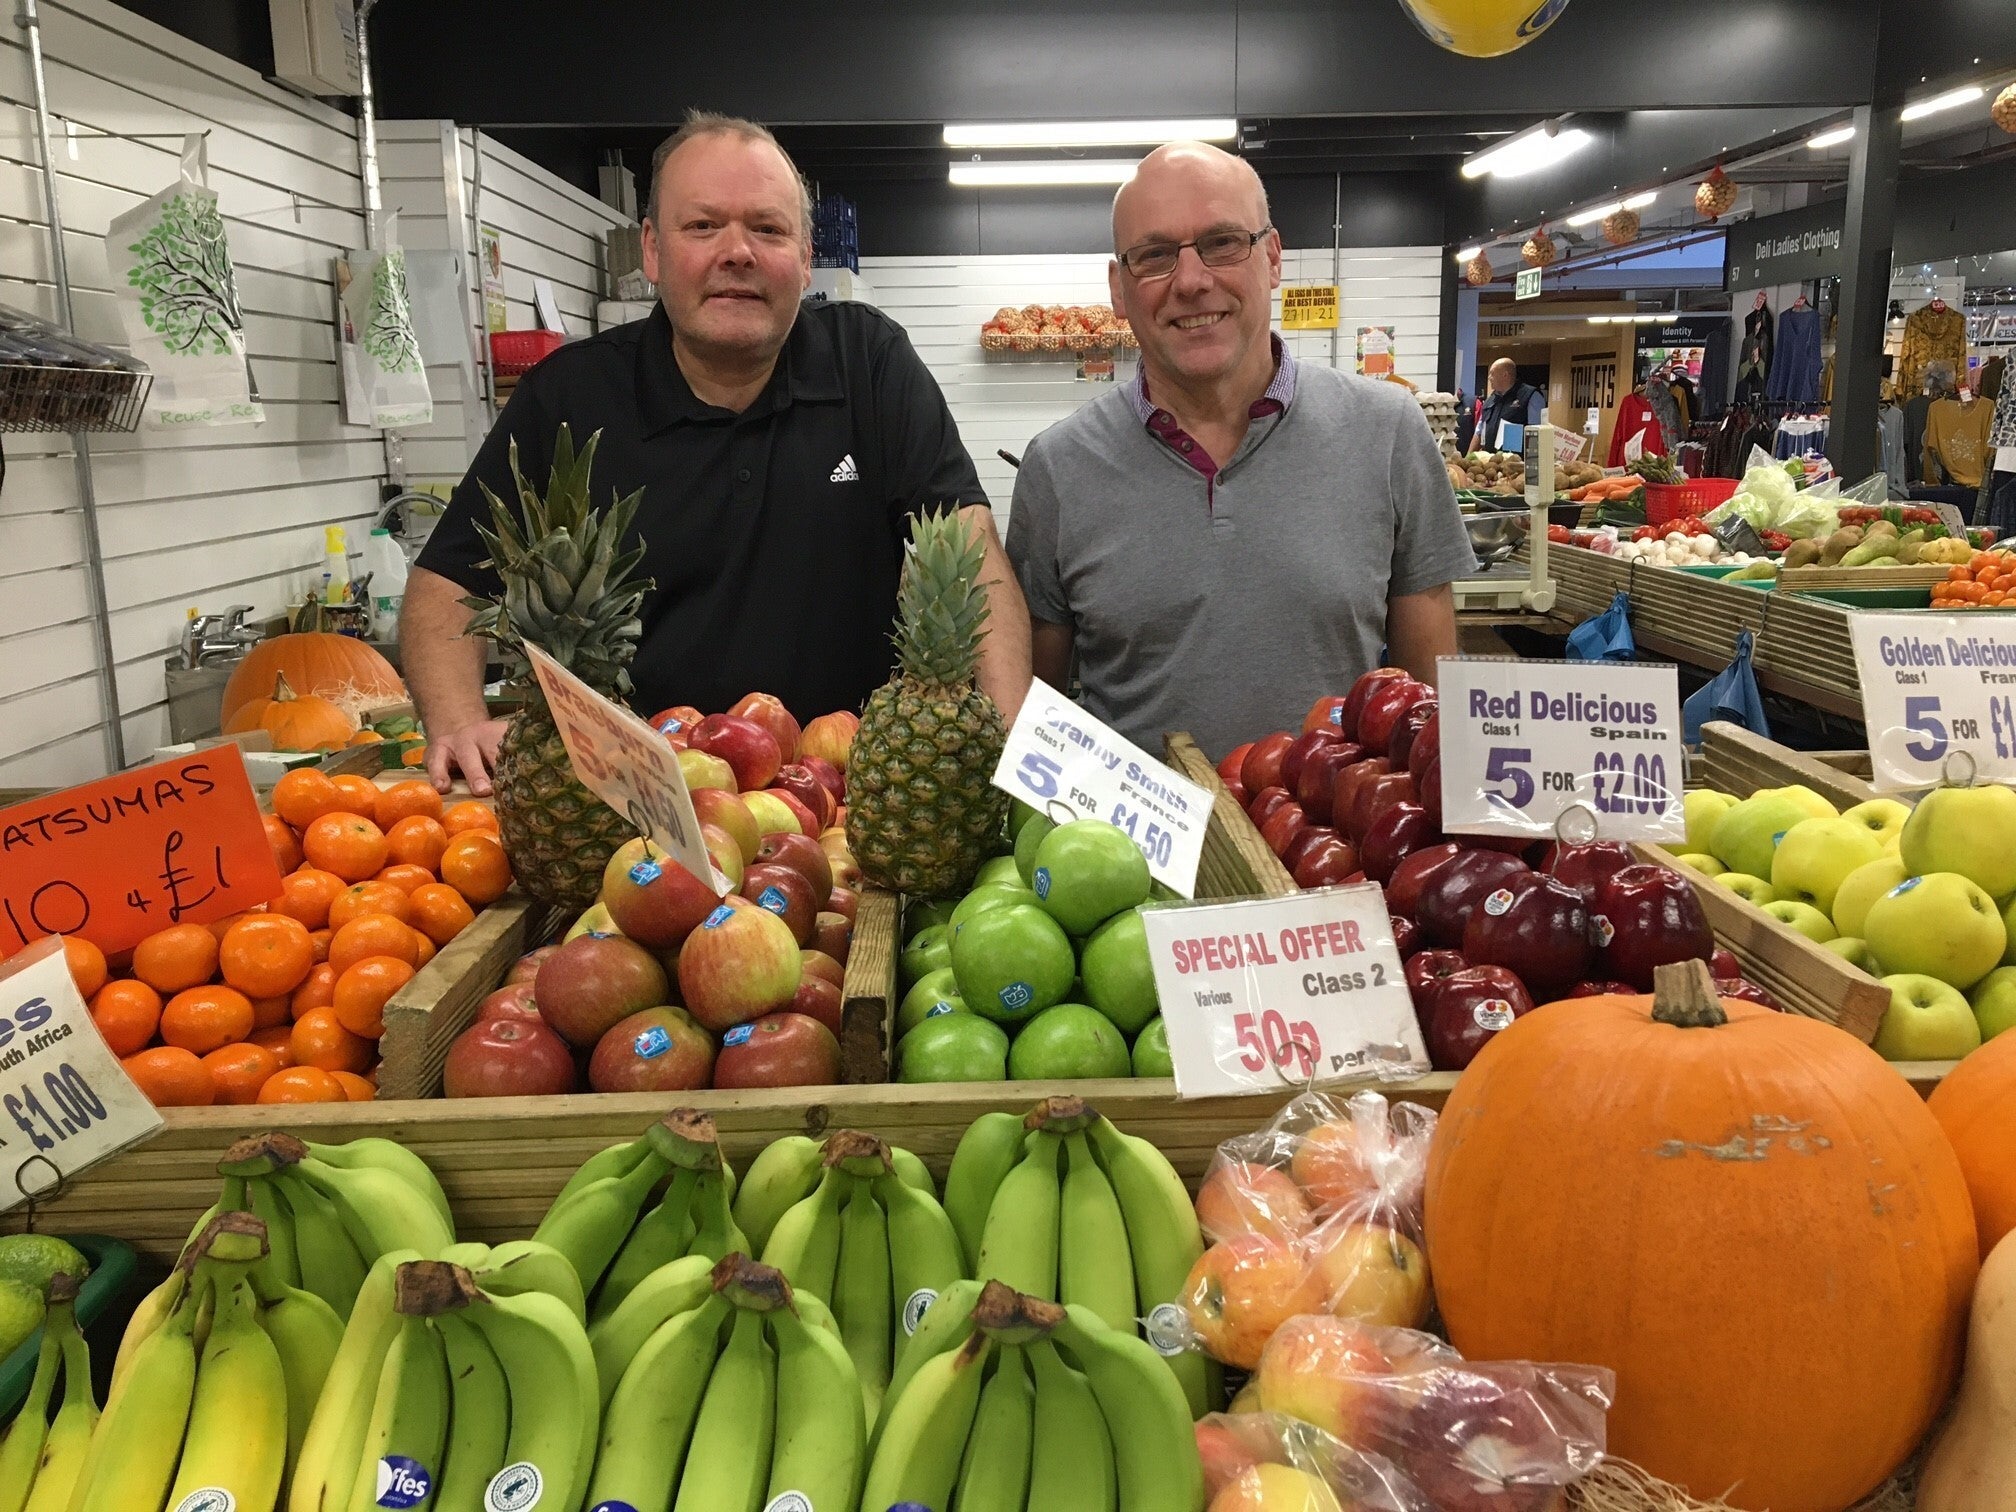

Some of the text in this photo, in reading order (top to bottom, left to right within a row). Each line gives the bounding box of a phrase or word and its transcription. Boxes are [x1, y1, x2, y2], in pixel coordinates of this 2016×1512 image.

[1756, 227, 1840, 260] Deli Ladies' Clothing
[1732, 267, 1740, 281] 57
[1284, 297, 1335, 307] ARE BEST BEFORE
[1489, 322, 1525, 337] TOILETS
[1662, 327, 1692, 337] Identity
[1570, 364, 1616, 409] TOILETS
[160, 411, 212, 424] Reuse
[1880, 636, 1945, 667] Golden
[1896, 670, 1920, 684] Class
[1922, 671, 1928, 684] 1
[541, 663, 666, 774] Braeburn
[1469, 688, 1657, 724] Red Delicious
[1482, 722, 1667, 741] Class 1 Spain
[1905, 696, 1949, 762] 5
[1952, 719, 1980, 739] FOR
[567, 721, 608, 781] 5
[1016, 751, 1063, 798] 5
[1069, 786, 1097, 813] FOR
[1034, 726, 1058, 748] Class
[1119, 781, 1190, 832] France
[1126, 762, 1188, 813] Smith
[1484, 747, 1666, 815] 5 FOR £2.00
[3, 764, 215, 851] ATSUMAS
[4, 830, 231, 946] 10 4 £1
[1171, 920, 1365, 974] SPECIAL OFFER
[1194, 990, 1233, 1007] Various
[1302, 963, 1387, 996] Class 2
[26, 1022, 73, 1057] Africa
[1233, 1009, 1366, 1077] 50p per
[3, 1063, 107, 1152] £1.00
